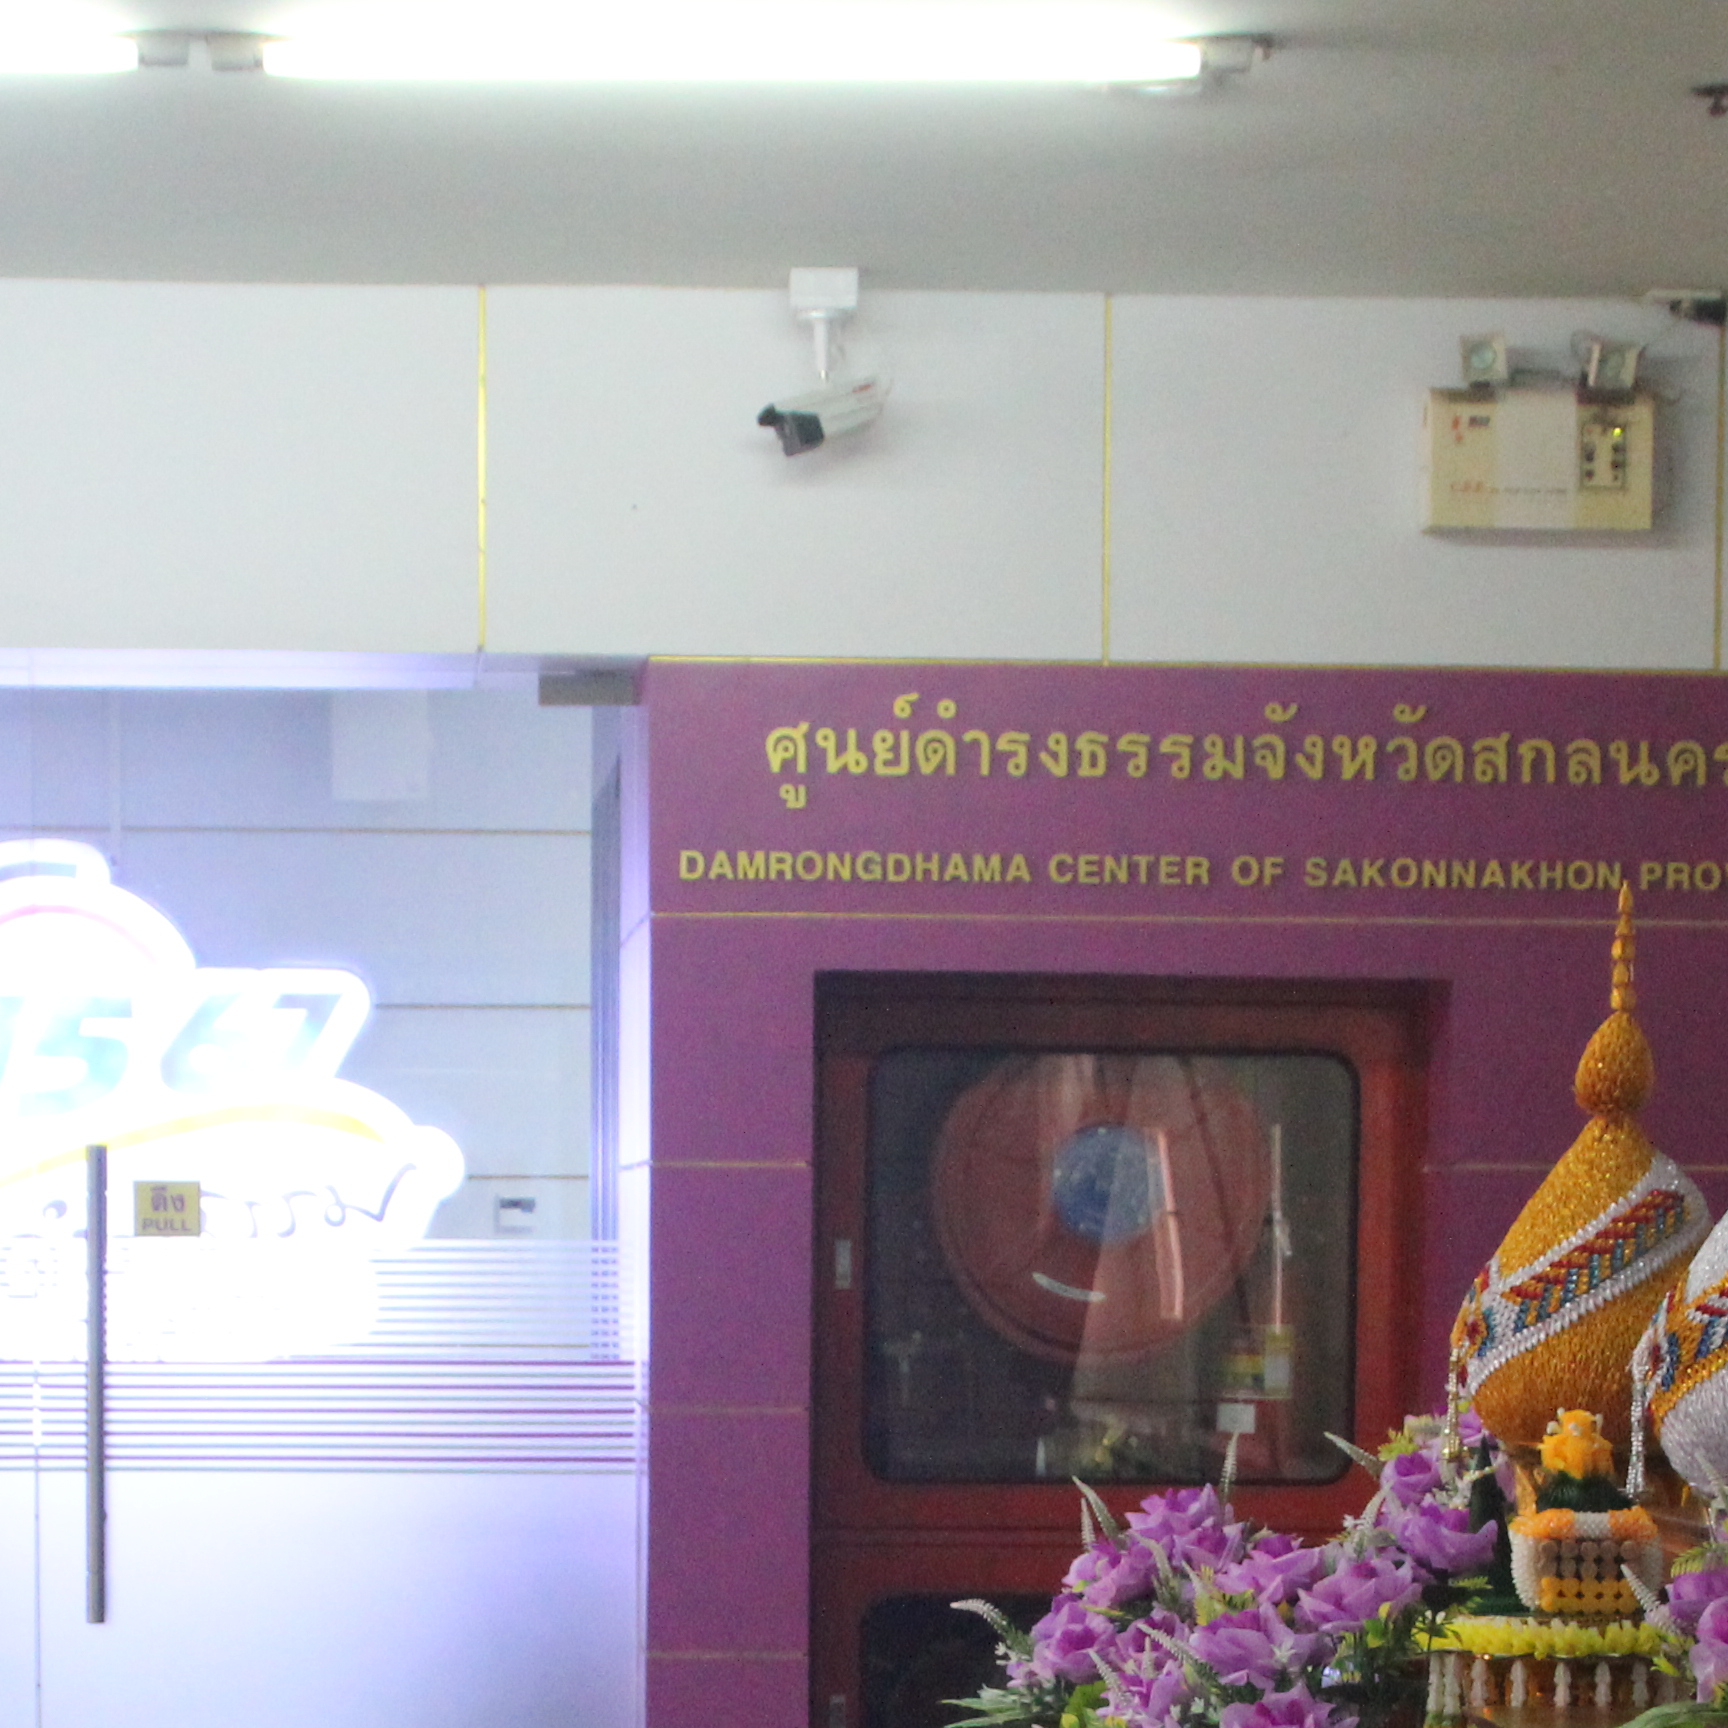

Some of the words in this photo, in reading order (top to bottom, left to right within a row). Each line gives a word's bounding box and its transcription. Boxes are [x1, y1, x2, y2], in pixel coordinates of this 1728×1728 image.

[678, 848, 1033, 884] DAMRONGDHAMA
[1047, 853, 1211, 886] CENTER
[1231, 855, 1284, 886] OF
[1303, 857, 1622, 891] SAKONNAKHON
[141, 1217, 191, 1232] PULL
